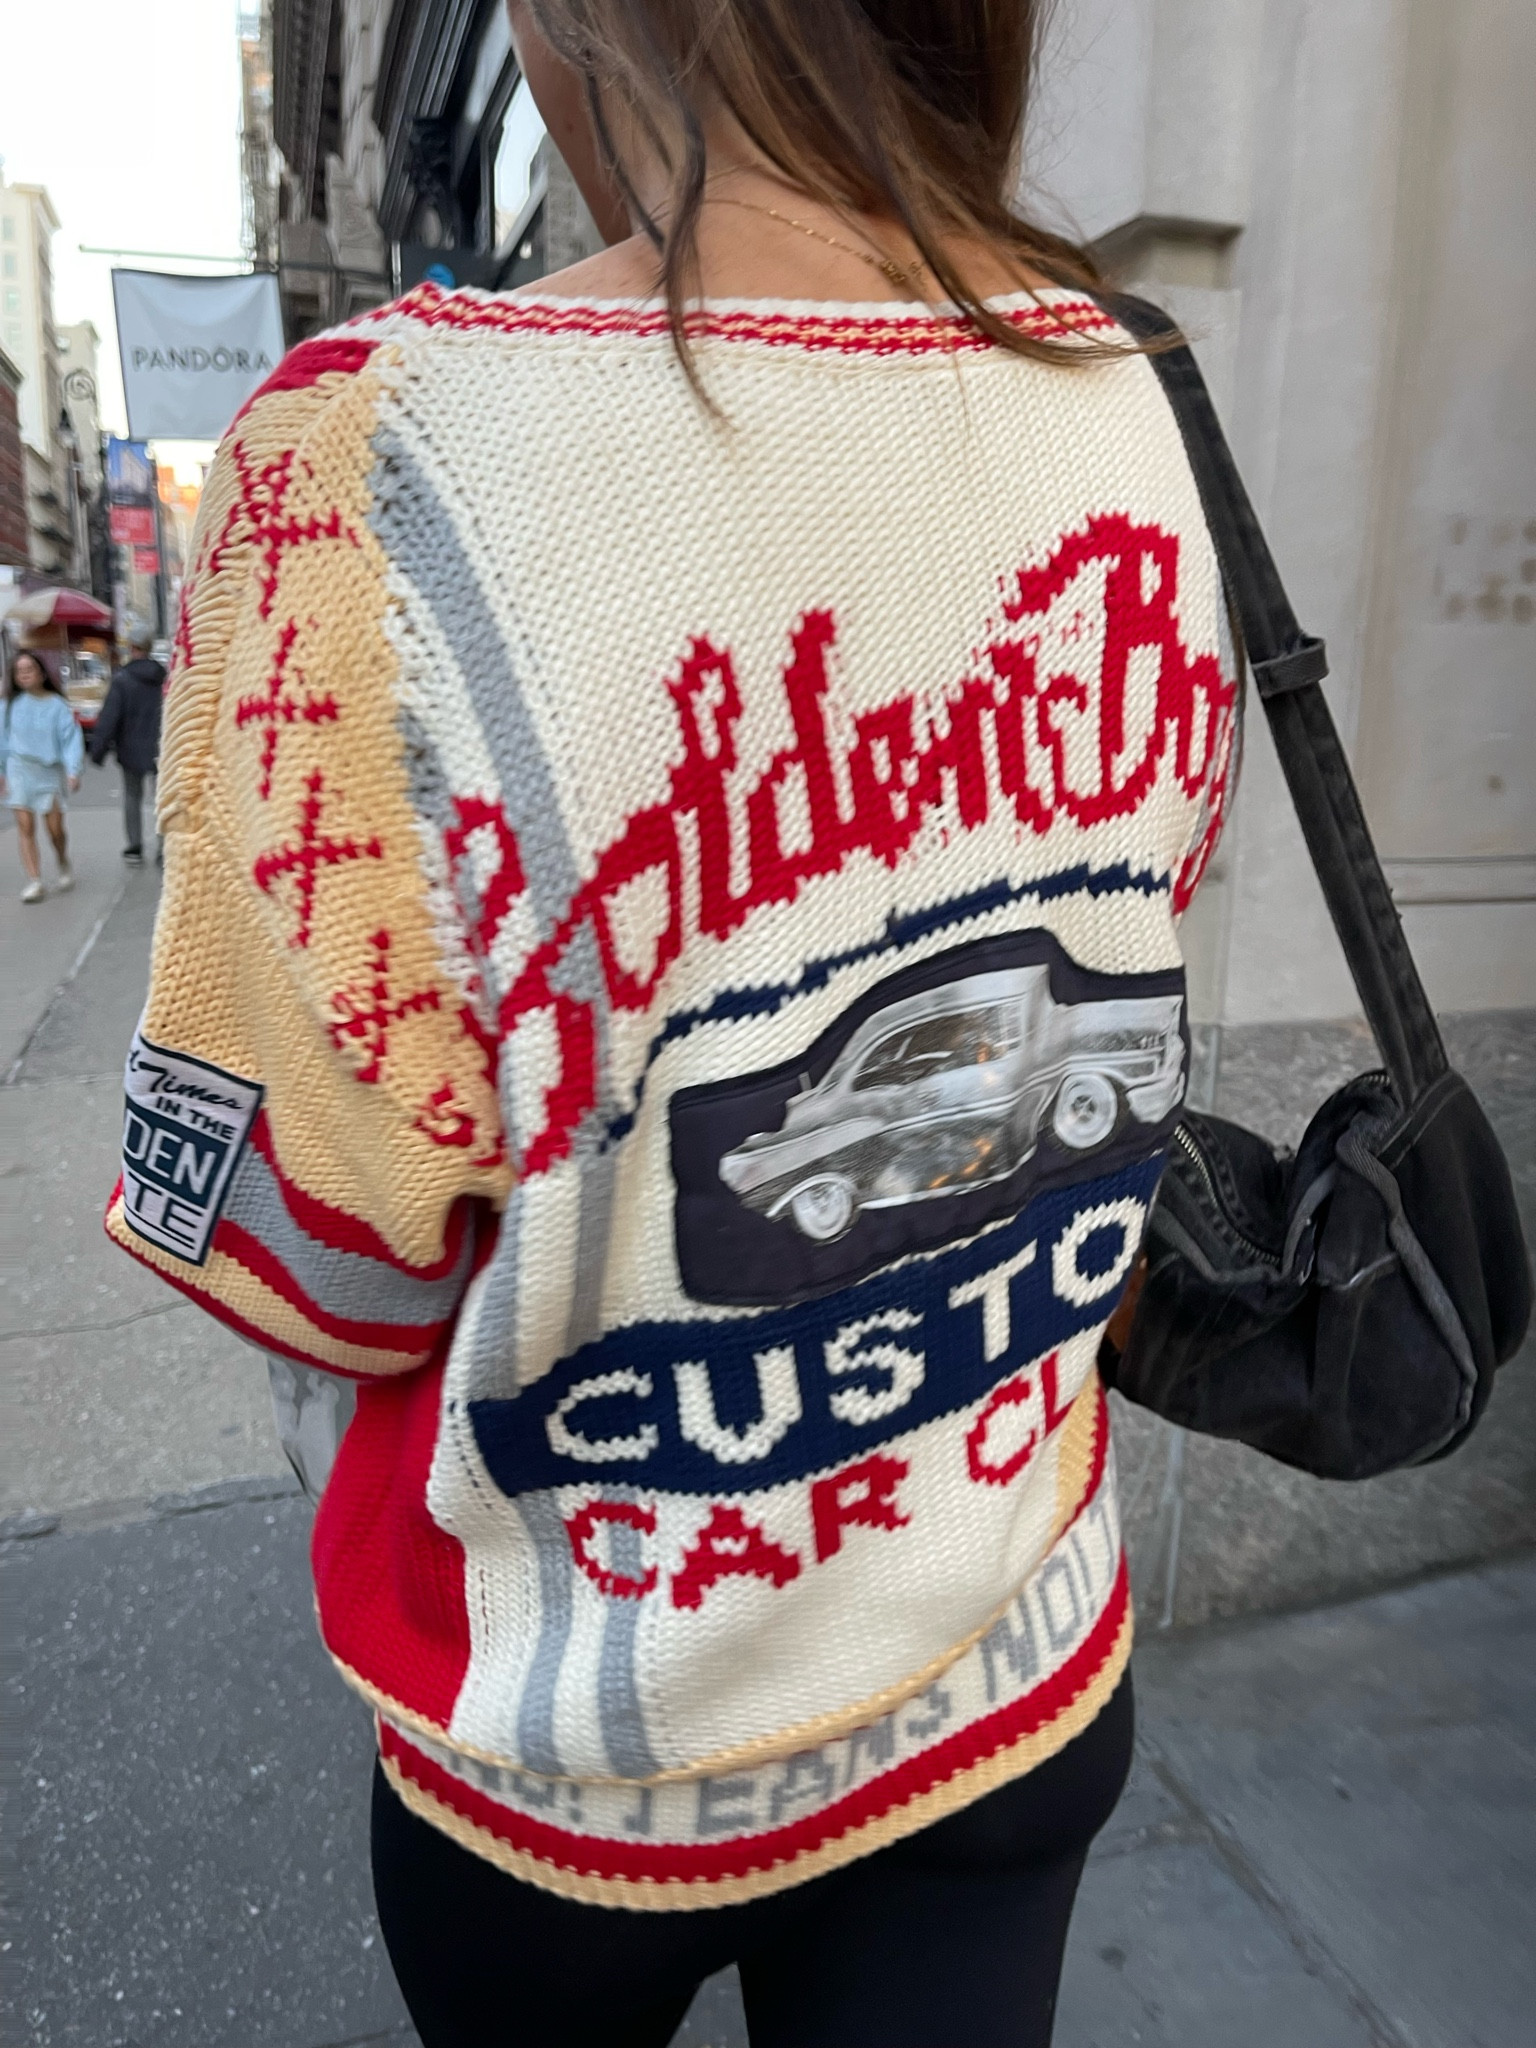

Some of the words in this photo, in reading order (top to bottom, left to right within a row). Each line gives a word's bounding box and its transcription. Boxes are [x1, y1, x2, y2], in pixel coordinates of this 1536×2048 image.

[138, 1060, 244, 1110] Times
[155, 1096, 181, 1116] IN
[189, 1109, 237, 1140] THE
[563, 1455, 911, 1612] CAR
